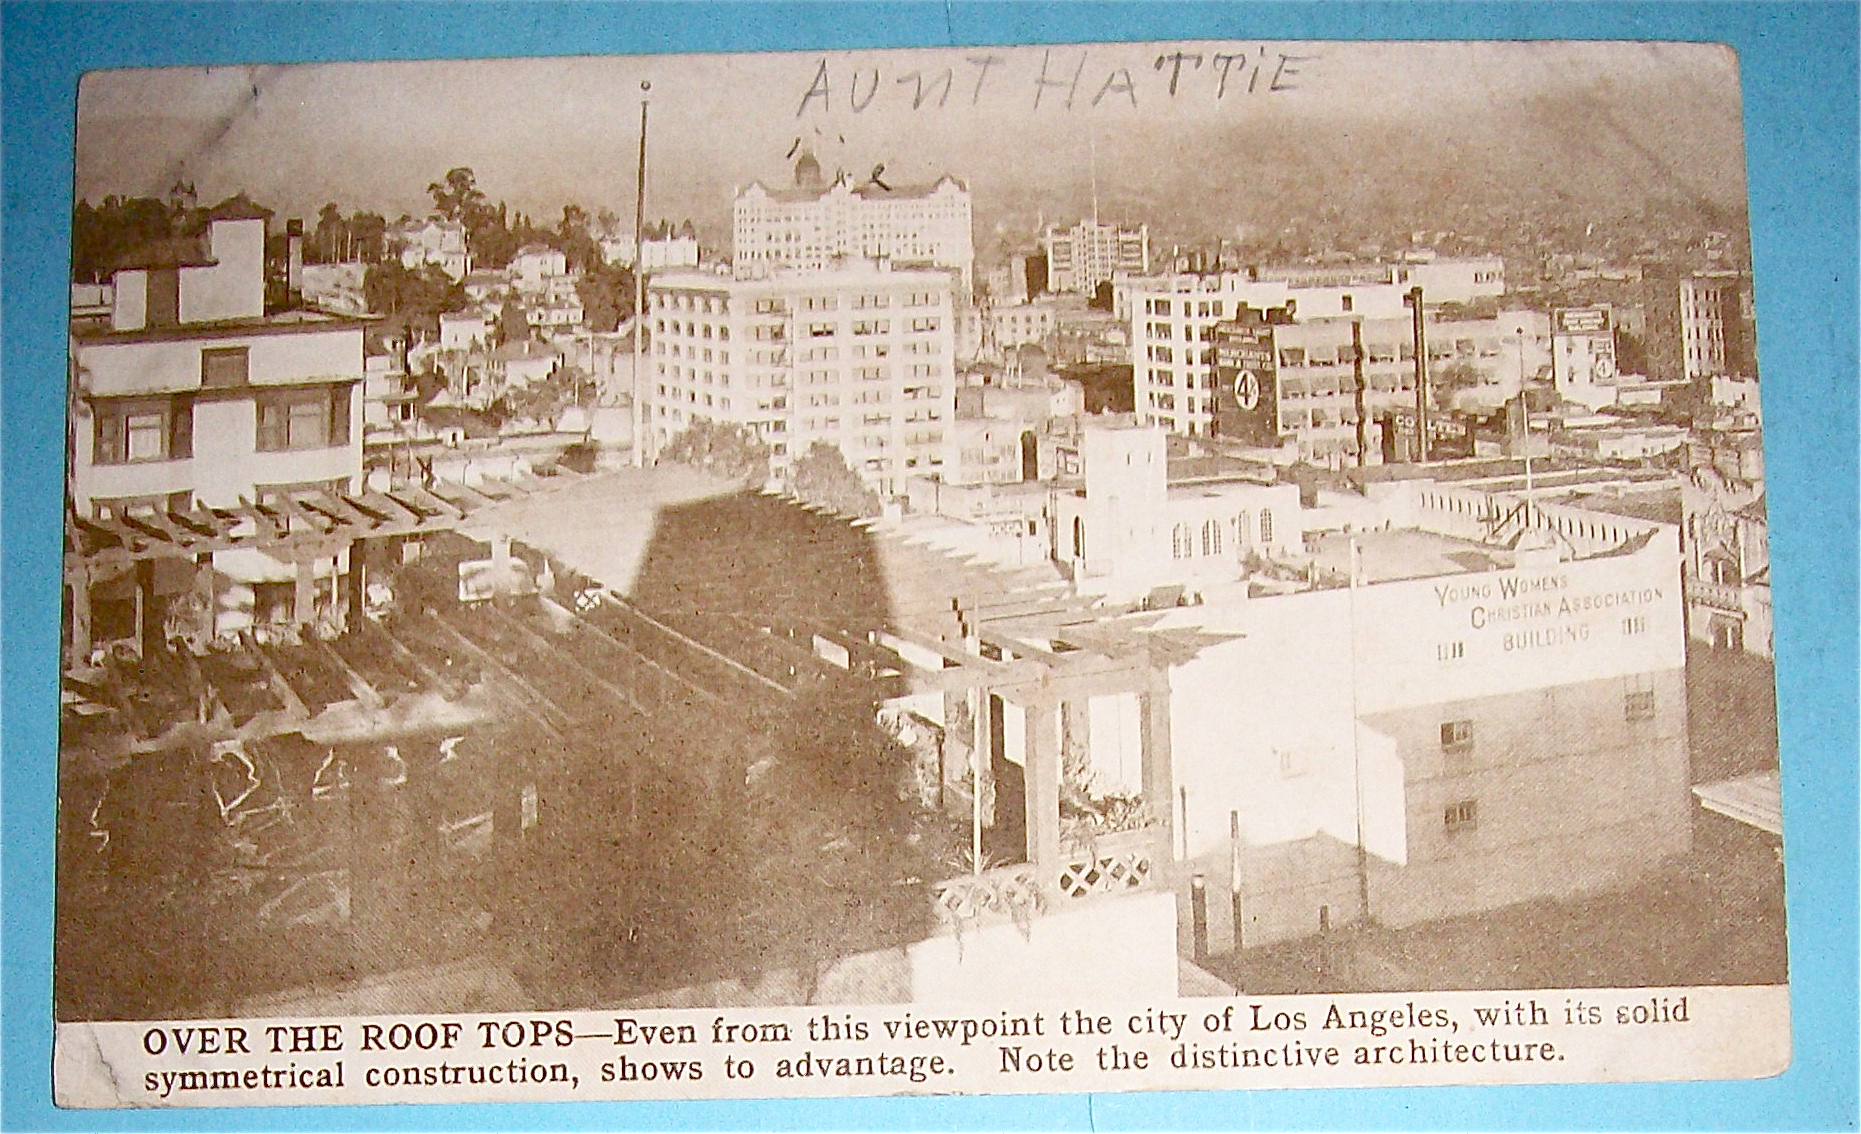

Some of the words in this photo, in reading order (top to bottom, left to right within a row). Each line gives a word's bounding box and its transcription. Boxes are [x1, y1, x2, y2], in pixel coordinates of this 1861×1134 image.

[1471, 602, 1551, 629] CHRISTIAN
[1558, 588, 1664, 616] ASSOCIATION
[1503, 624, 1590, 651] BUILDING
[144, 1028, 250, 1055] OVER
[265, 1025, 343, 1053] THE
[361, 1023, 462, 1051] ROOF
[712, 1017, 791, 1043] from
[807, 1014, 869, 1041] this
[883, 1012, 1044, 1046] viewpoint
[1060, 1010, 1112, 1035] the
[1128, 1008, 1187, 1041] city
[1203, 1006, 1233, 1032] of
[1249, 1005, 1307, 1031] Los
[1322, 1003, 1458, 1037] Angeles,
[1474, 1000, 1548, 1027] with
[1564, 1002, 1601, 1026] its
[1616, 997, 1690, 1024] solid
[145, 1061, 344, 1098] symmetrical
[366, 1058, 578, 1089] construction,
[601, 1055, 702, 1082] shows
[725, 1055, 754, 1079] to
[776, 1050, 954, 1082] advantage.
[999, 1047, 1074, 1073] Note
[1096, 1045, 1148, 1070] the
[1171, 1040, 1339, 1069] distinctive
[1354, 1037, 1564, 1064] architecture.
